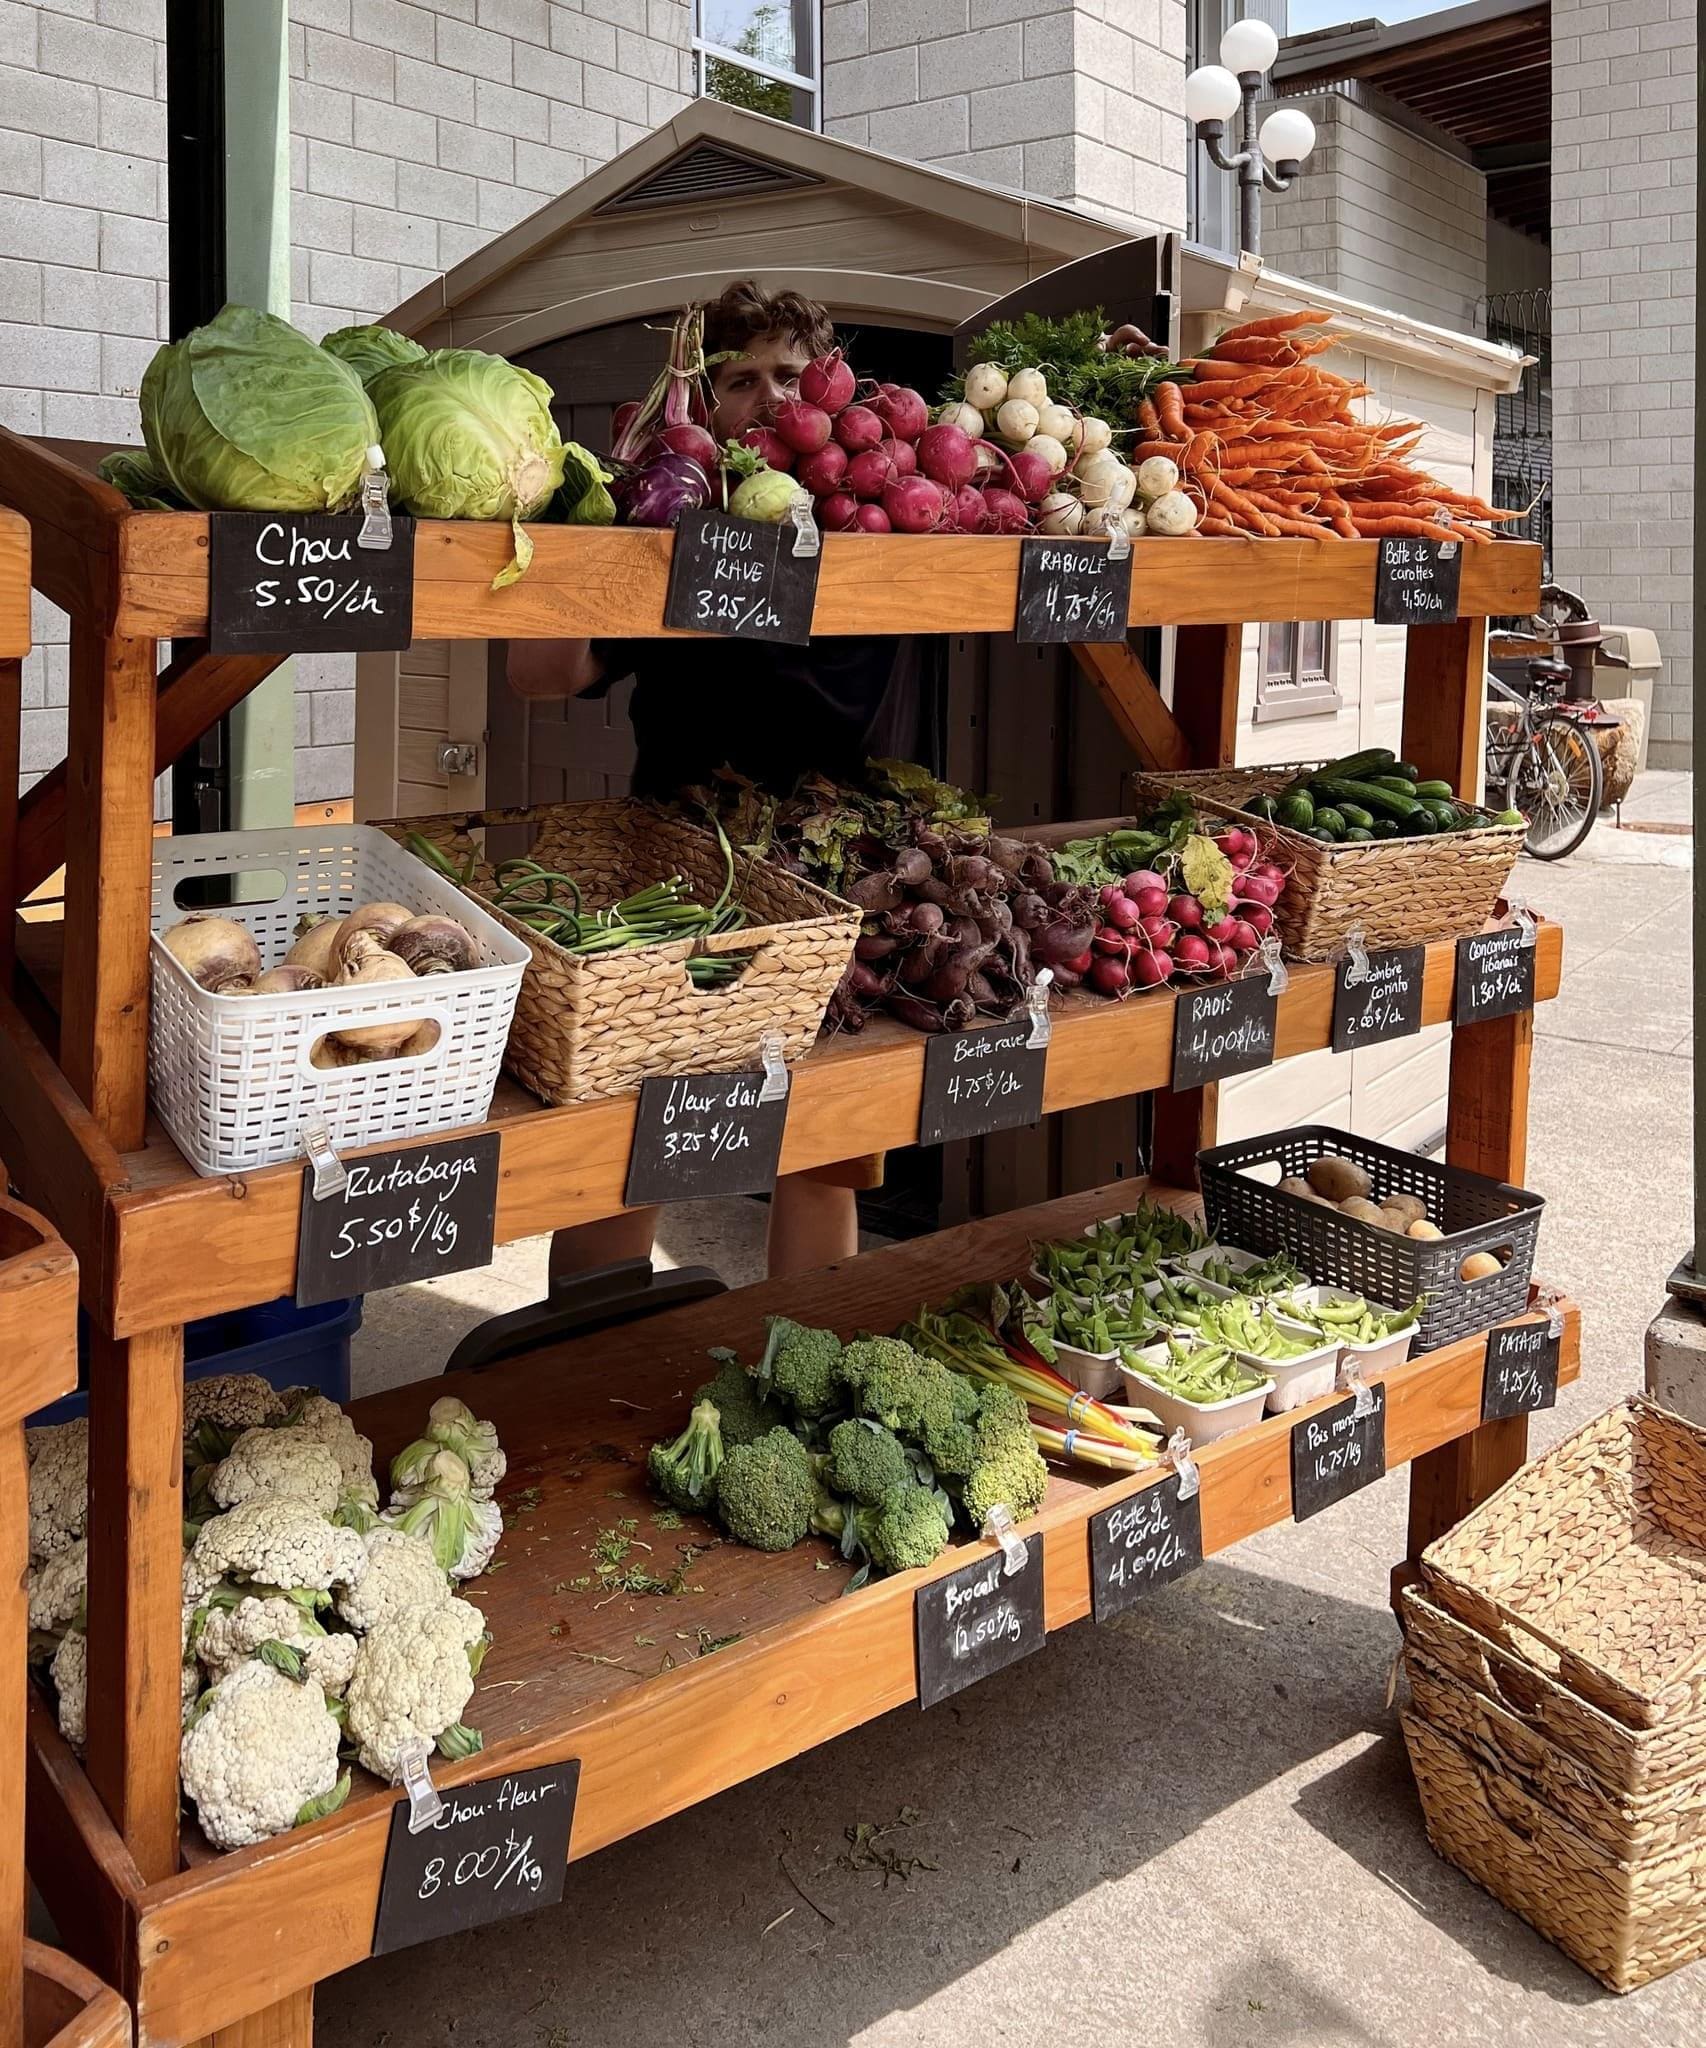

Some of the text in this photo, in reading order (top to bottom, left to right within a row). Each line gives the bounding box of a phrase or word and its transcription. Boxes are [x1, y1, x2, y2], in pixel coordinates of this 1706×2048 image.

[256, 523, 352, 567] Chou
[701, 522, 752, 554] CHOU
[1385, 541, 1429, 565] Botte de
[714, 558, 765, 582] RAVE
[1040, 550, 1107, 575] RABIOLE
[1391, 565, 1434, 581] carottes
[255, 576, 384, 619] 5.50/ch
[697, 590, 781, 631] 3.25/ch
[1482, 955, 1519, 974] libanais
[663, 1080, 720, 1125] fleur
[344, 1154, 478, 1204] Rutabaga
[1307, 1422, 1329, 1451] Pois
[433, 1779, 557, 1830] Chou-fleur
